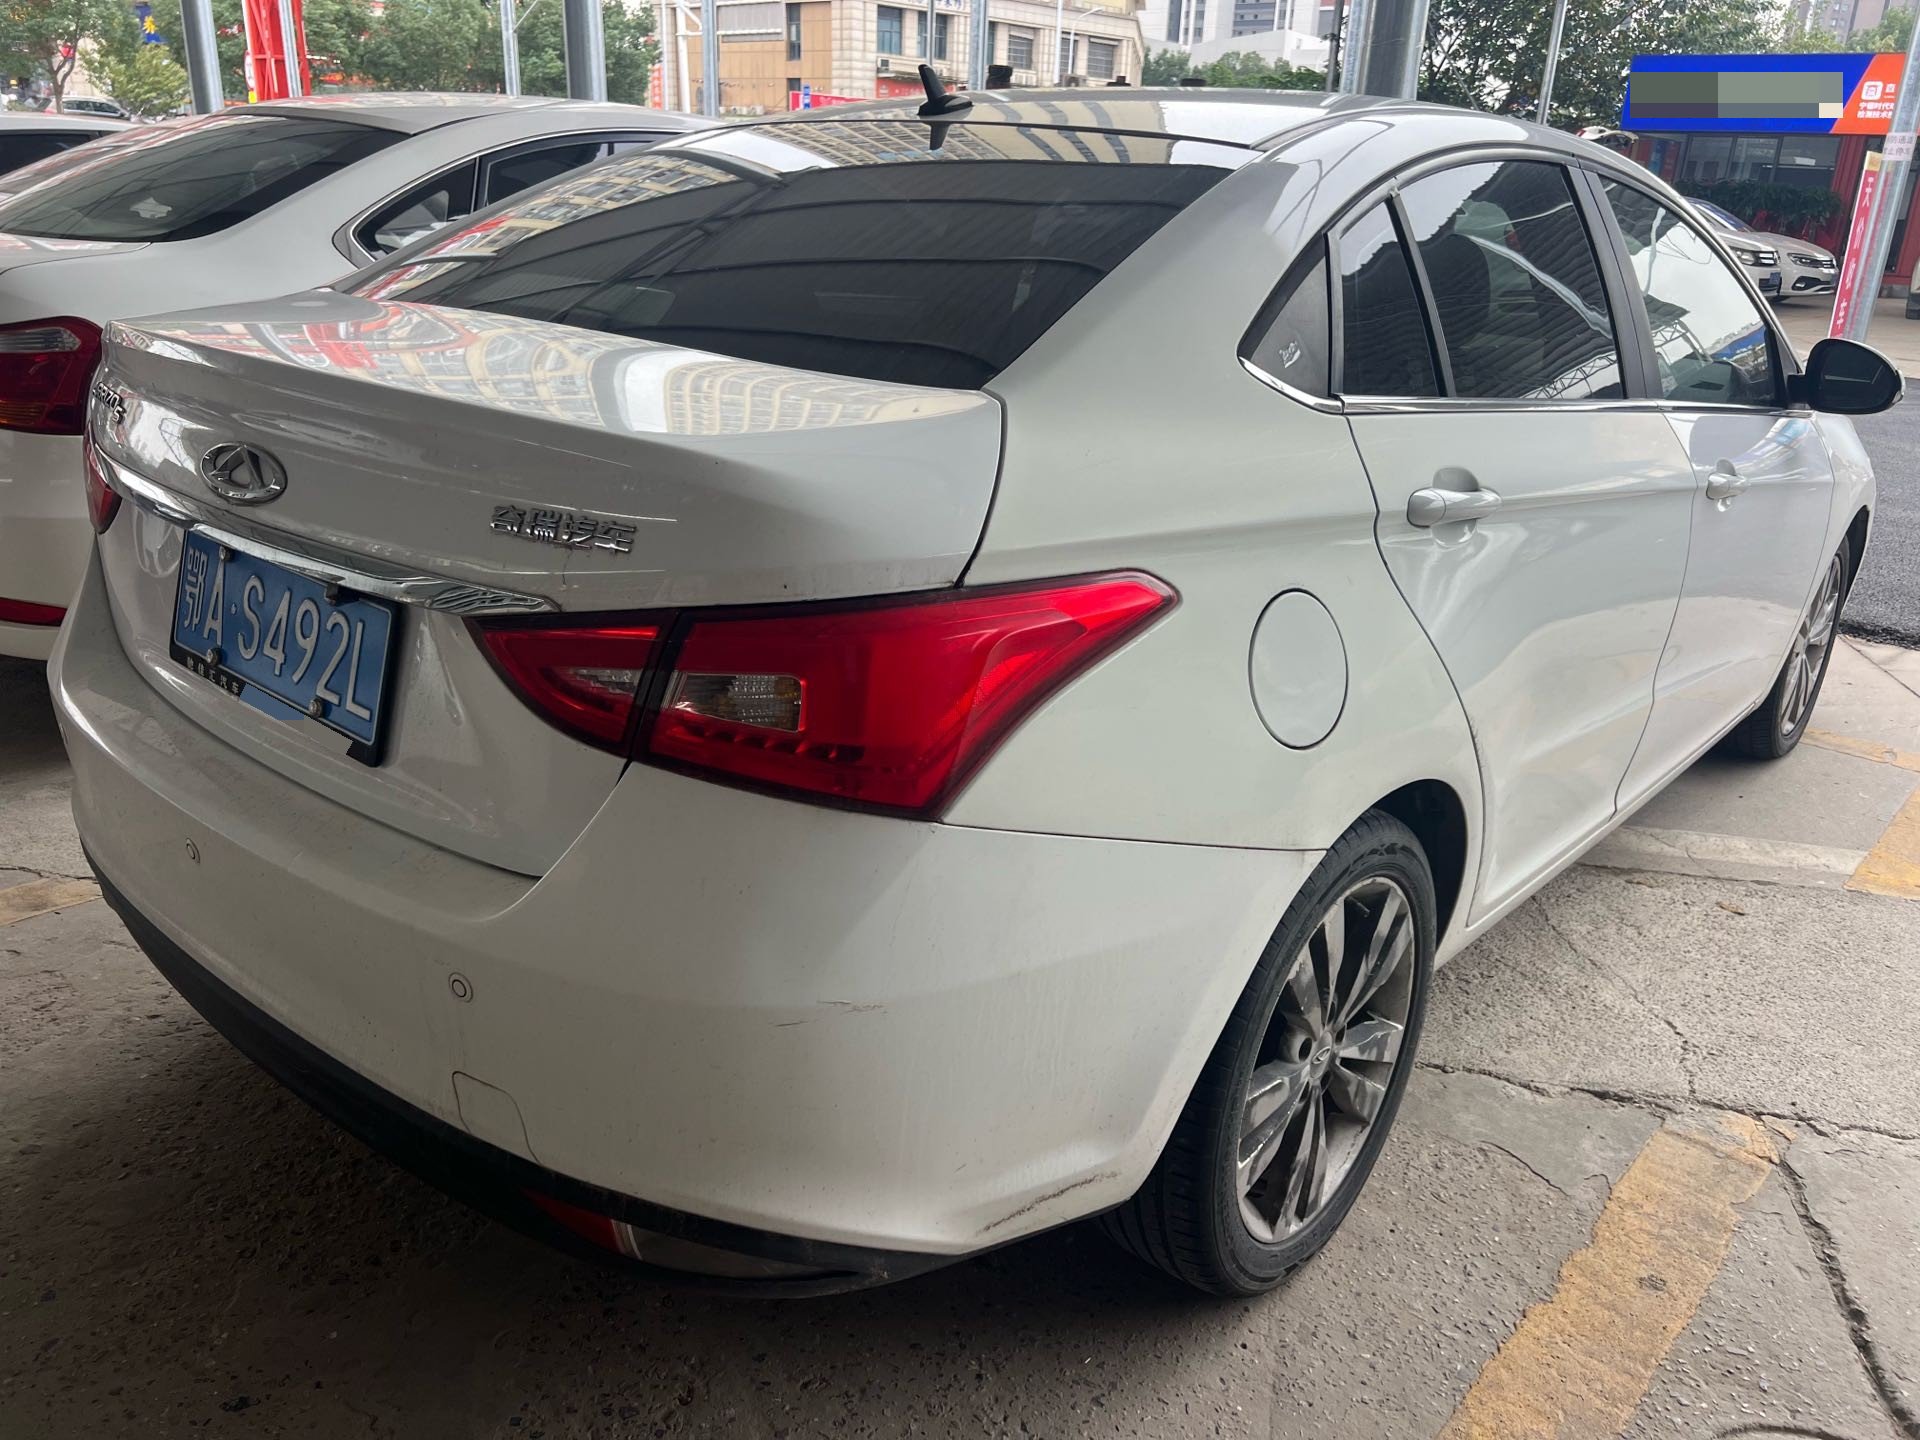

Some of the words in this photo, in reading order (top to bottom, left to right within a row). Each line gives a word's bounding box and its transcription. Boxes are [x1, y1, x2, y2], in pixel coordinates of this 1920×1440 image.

[112, 404, 126, 423] 5
[490, 504, 637, 553] 奇瑞汽车
